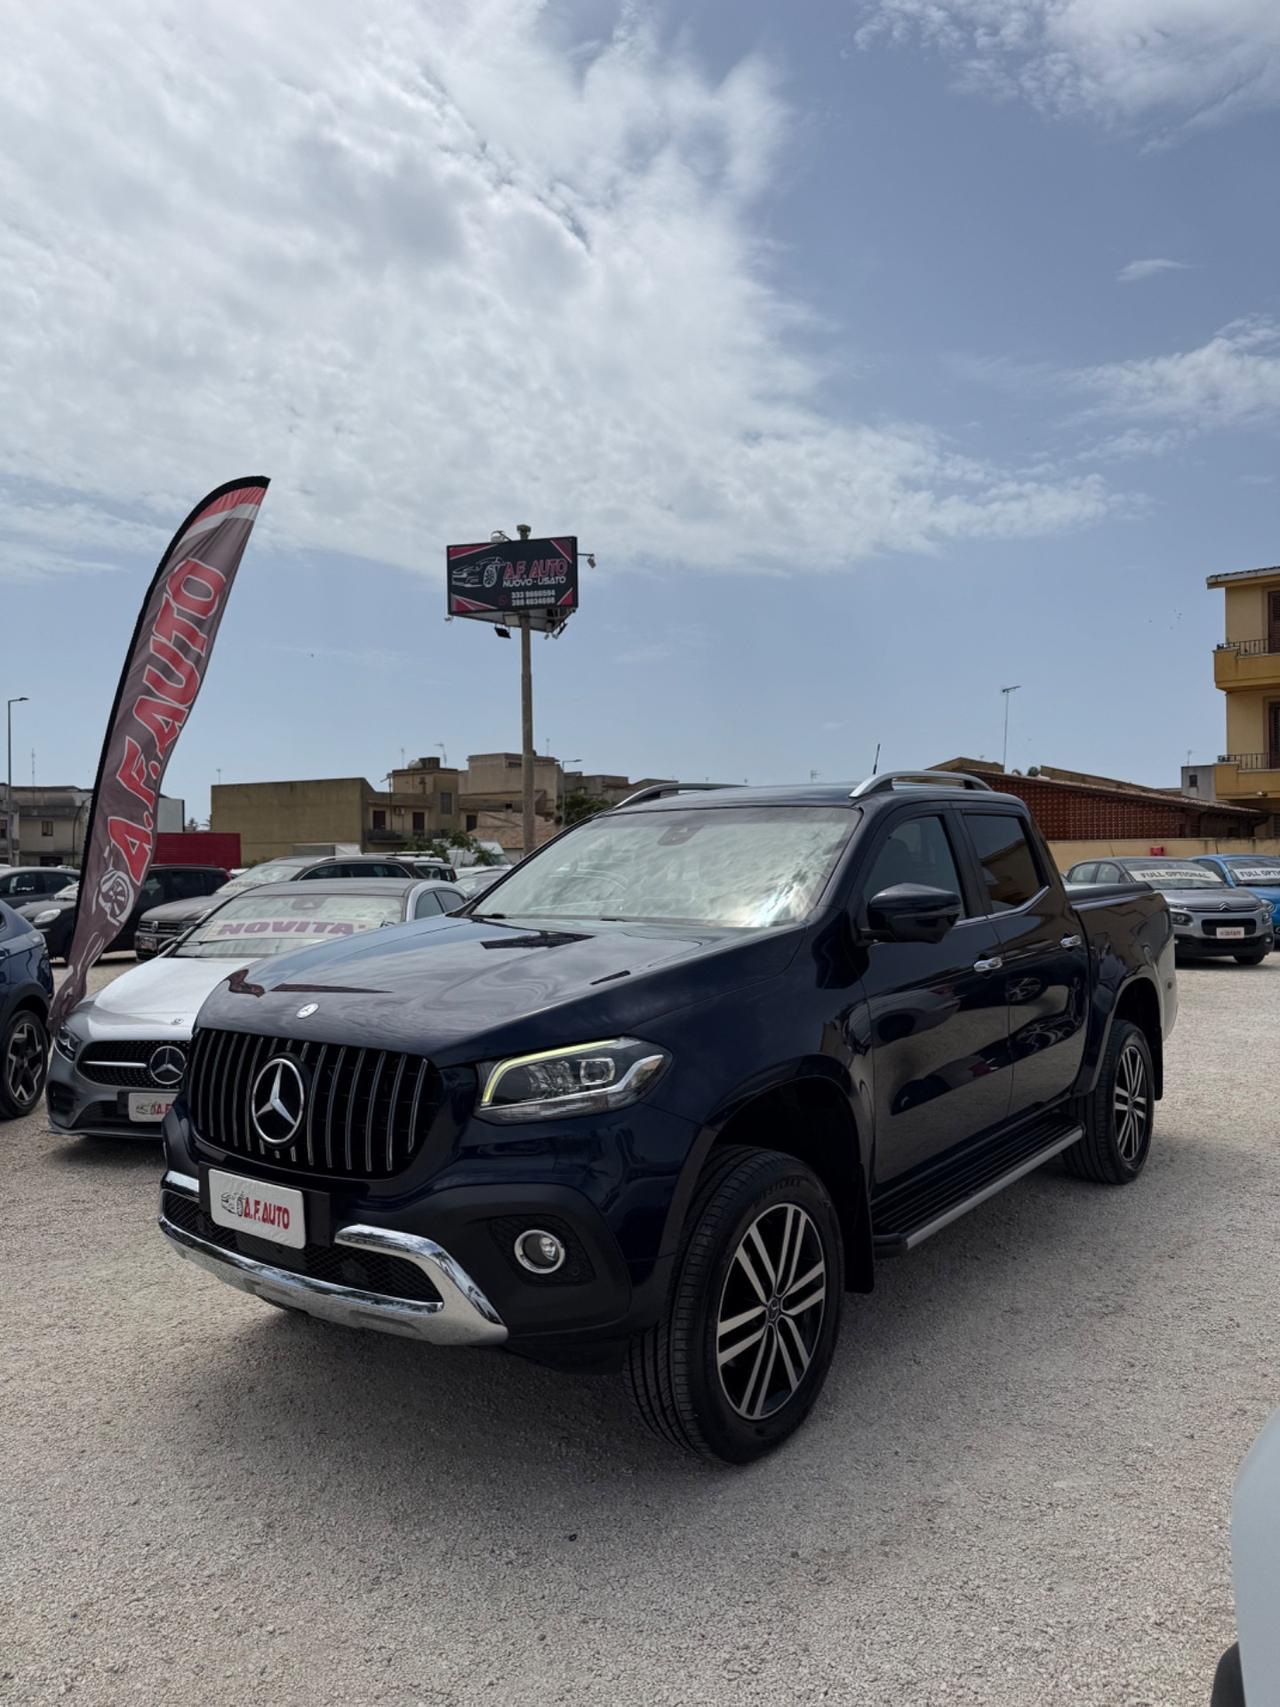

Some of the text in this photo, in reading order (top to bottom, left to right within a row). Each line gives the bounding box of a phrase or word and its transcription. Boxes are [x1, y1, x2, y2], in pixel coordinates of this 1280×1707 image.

[529, 559, 567, 578] AUTO
[503, 578, 533, 587] NUOVO
[537, 576, 566, 585] USATO
